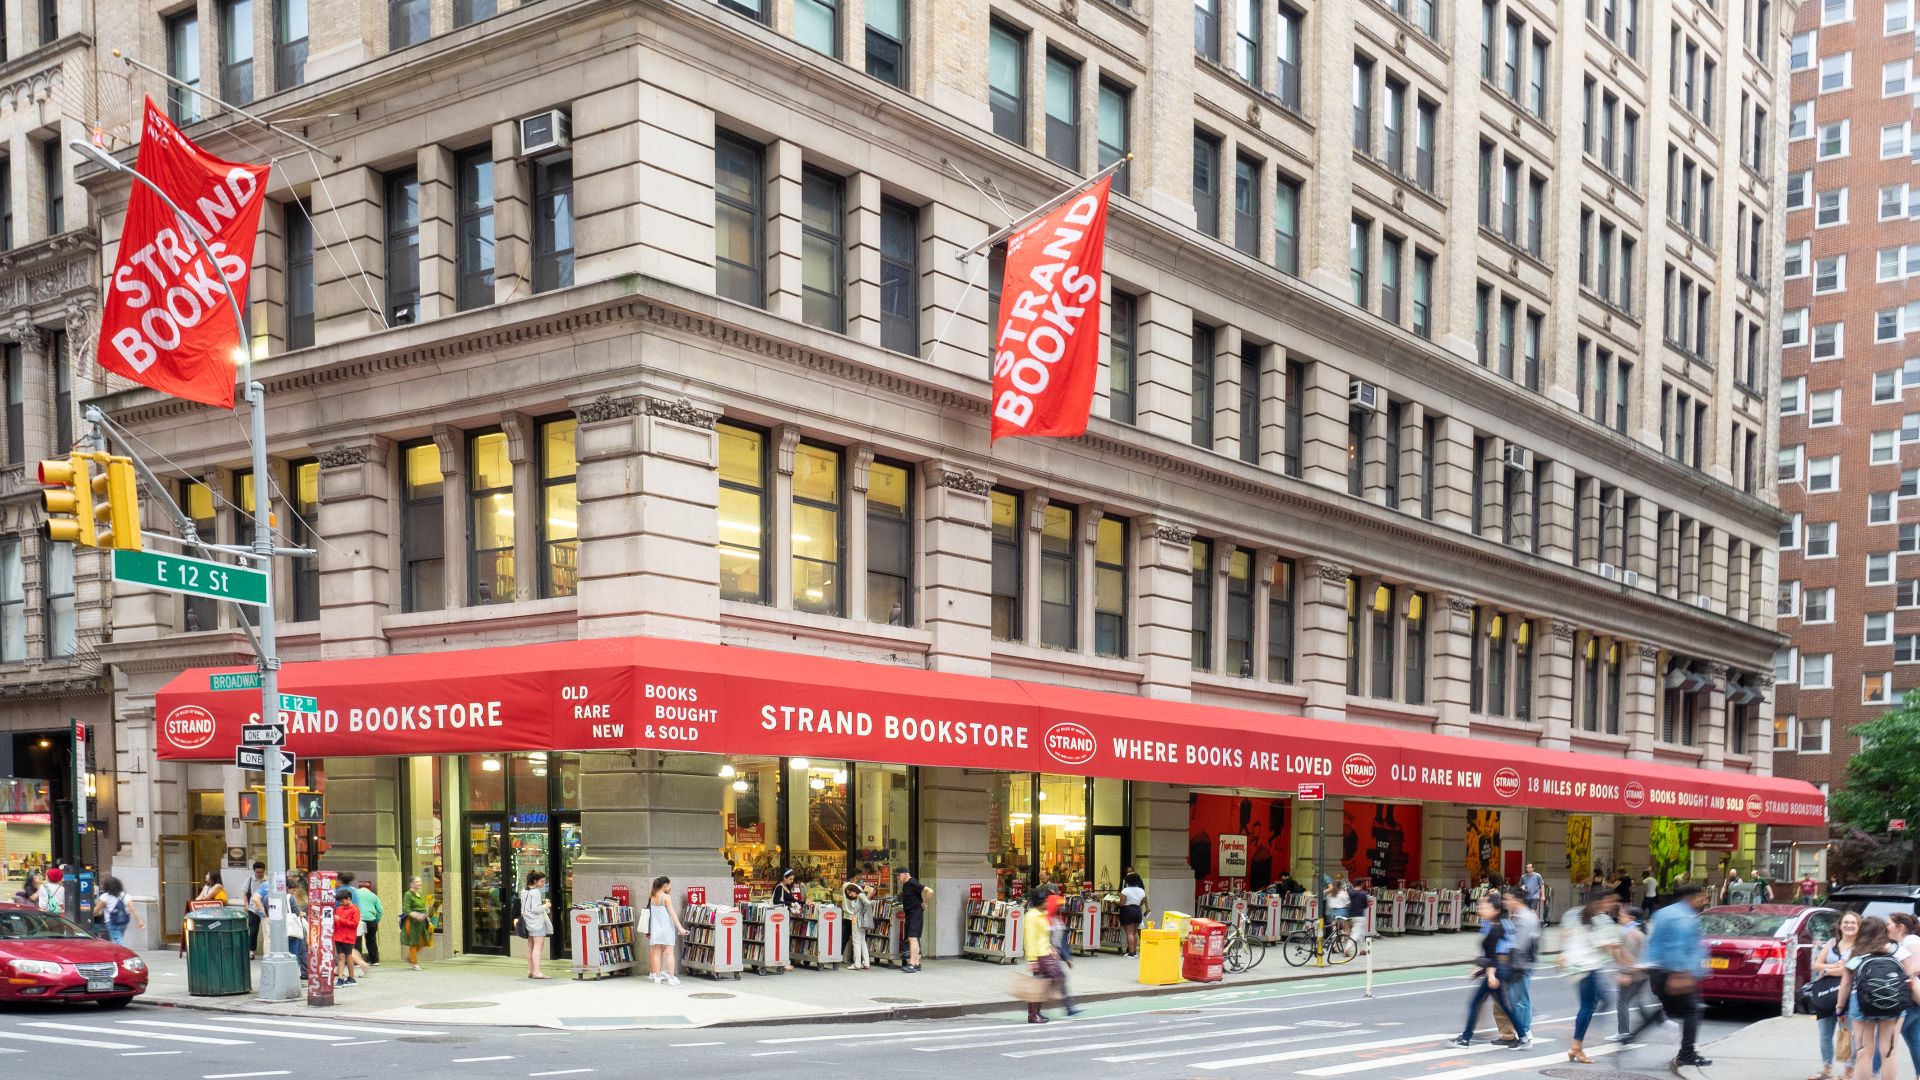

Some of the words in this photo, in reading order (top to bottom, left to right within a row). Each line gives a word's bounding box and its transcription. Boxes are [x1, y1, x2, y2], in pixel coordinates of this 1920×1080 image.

[115, 167, 257, 309] STRAND
[993, 194, 1098, 378] STRAND
[111, 241, 248, 375] BOOKS
[994, 265, 1097, 429] BOOKS
[157, 560, 168, 582] E
[178, 563, 199, 588] 12
[209, 570, 229, 593] St
[213, 674, 259, 689] BROADWAY
[561, 685, 589, 700] OLD
[644, 684, 698, 702] BOOKS
[283, 696, 290, 709] E
[294, 697, 304, 711] 12
[574, 704, 611, 719] RARE
[249, 709, 339, 735] SRAND
[349, 700, 503, 733] BOOKSTORE
[655, 705, 718, 723] BOUGHT
[169, 719, 212, 734] STRAND
[248, 731, 261, 740] ONE
[265, 730, 278, 738] WAY
[592, 723, 625, 739] NEW
[644, 725, 656, 739] &
[659, 725, 699, 741] SOLD
[760, 704, 873, 737] STRAND
[885, 715, 1029, 749] BOOKSTORE
[1049, 734, 1093, 752] STRAND
[245, 753, 263, 764] ONE
[1113, 737, 1178, 763] WHERE
[1186, 744, 1243, 767] BOOKS
[1249, 751, 1280, 772] ARE
[1286, 755, 1332, 776] LOVED
[1345, 763, 1374, 777] STRAND
[1391, 763, 1417, 782] OLD
[1421, 766, 1453, 786] RARE
[1457, 771, 1482, 789] NEW
[1495, 776, 1519, 788] STRAND
[1527, 777, 1540, 793] 18
[1543, 779, 1571, 796] MILES
[1574, 782, 1587, 797] OF
[1589, 783, 1619, 800] BOOKS
[1650, 788, 1676, 805] BOOKS
[1678, 792, 1709, 809] BOUGHT
[1710, 795, 1725, 810] AND
[1726, 797, 1744, 812] SOLD
[1765, 800, 1789, 815] STRAND
[1790, 802, 1823, 817] BOOKSTORE
[690, 893, 702, 903] $1
